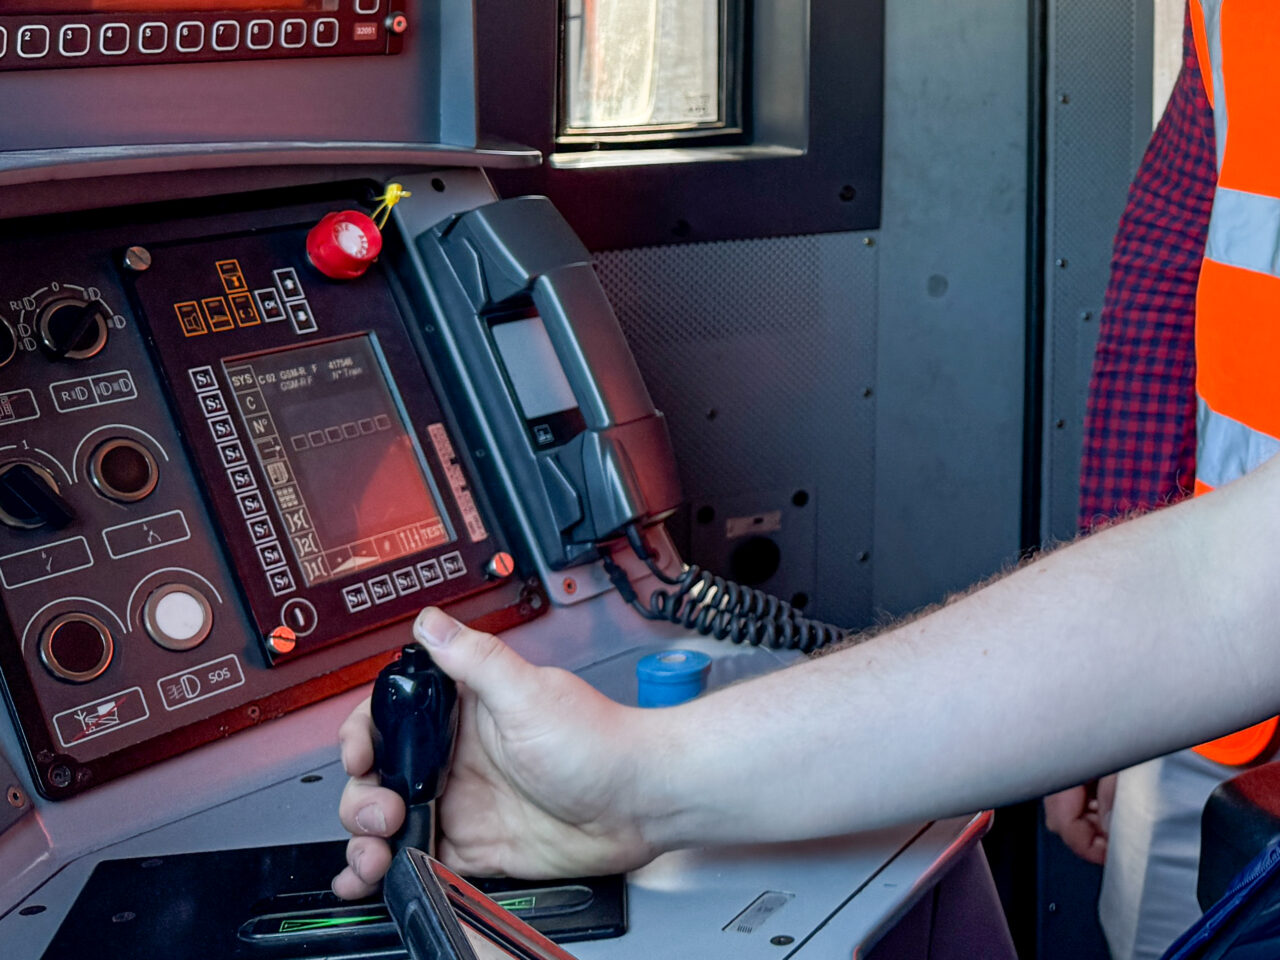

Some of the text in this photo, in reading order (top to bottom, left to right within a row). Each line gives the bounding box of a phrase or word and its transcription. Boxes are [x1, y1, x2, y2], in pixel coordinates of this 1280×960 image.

[66, 30, 73, 39] 3
[106, 29, 113, 38] 4
[145, 28, 151, 37] 5
[182, 27, 189, 36] 6
[218, 26, 225, 35] 7
[24, 31, 31, 40] 2
[51, 281, 60, 292] 0
[264, 300, 277, 310] OK
[231, 373, 253, 387] SYS
[246, 396, 256, 410] C
[208, 668, 231, 683] SOS
